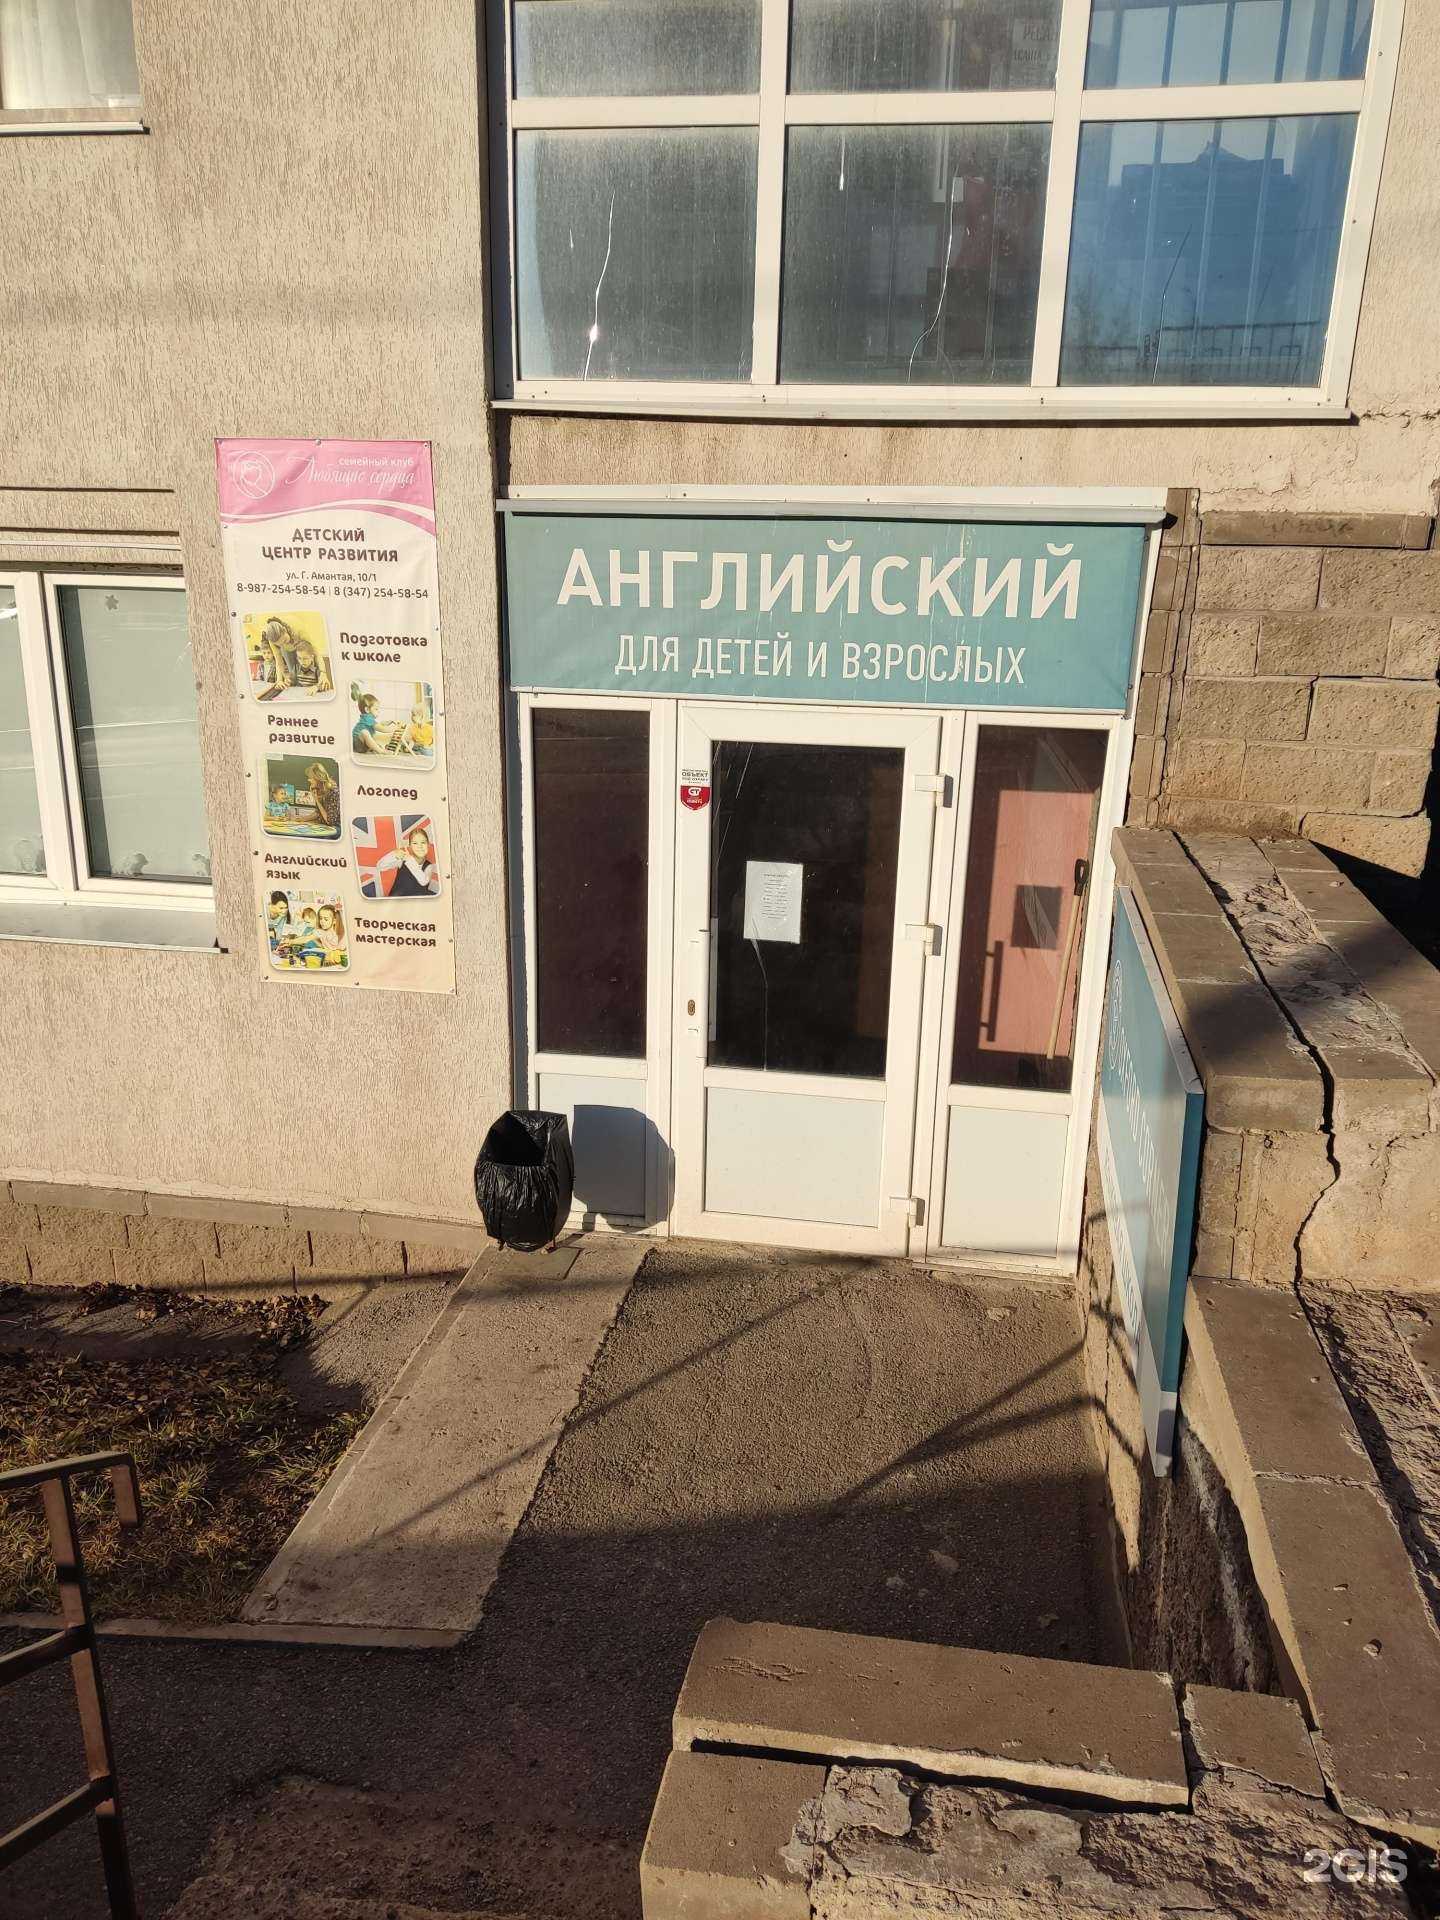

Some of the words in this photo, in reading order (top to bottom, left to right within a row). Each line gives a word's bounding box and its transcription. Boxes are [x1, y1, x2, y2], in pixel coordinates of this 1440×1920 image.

[390, 458, 415, 466] клуб
[369, 470, 416, 496] сердца
[292, 527, 365, 543] ДЕТСКИЙ
[262, 546, 312, 561] ЦЕНТР
[318, 547, 399, 562] РАЗВИТИЯ
[285, 572, 300, 581] ул.
[301, 571, 310, 580] Г.
[311, 571, 356, 583] Амантая,
[357, 573, 377, 583] 10/1
[556, 539, 1083, 620] АНГЛИЙСКИЙ
[237, 583, 326, 596] 8-987-254-58-54
[334, 586, 341, 596] 8
[343, 586, 371, 599] (347)
[373, 587, 429, 599] 254-58-54
[339, 632, 428, 648] Подготовка
[341, 651, 350, 661] к
[353, 651, 401, 663] школе
[615, 633, 680, 675] ДЛЯ
[692, 631, 794, 680] ДЕТЕЙ
[808, 641, 828, 679] И
[842, 641, 1027, 686] ВЗРОСЛЫХ
[267, 714, 319, 728] Раннее
[269, 732, 335, 746] развитие
[356, 784, 419, 801] Логопед
[264, 853, 348, 869] Английский
[266, 869, 301, 881] язык
[354, 917, 436, 933] Творческая
[355, 934, 437, 948] мастерская
[1119, 1026, 1141, 1142] OXFORD
